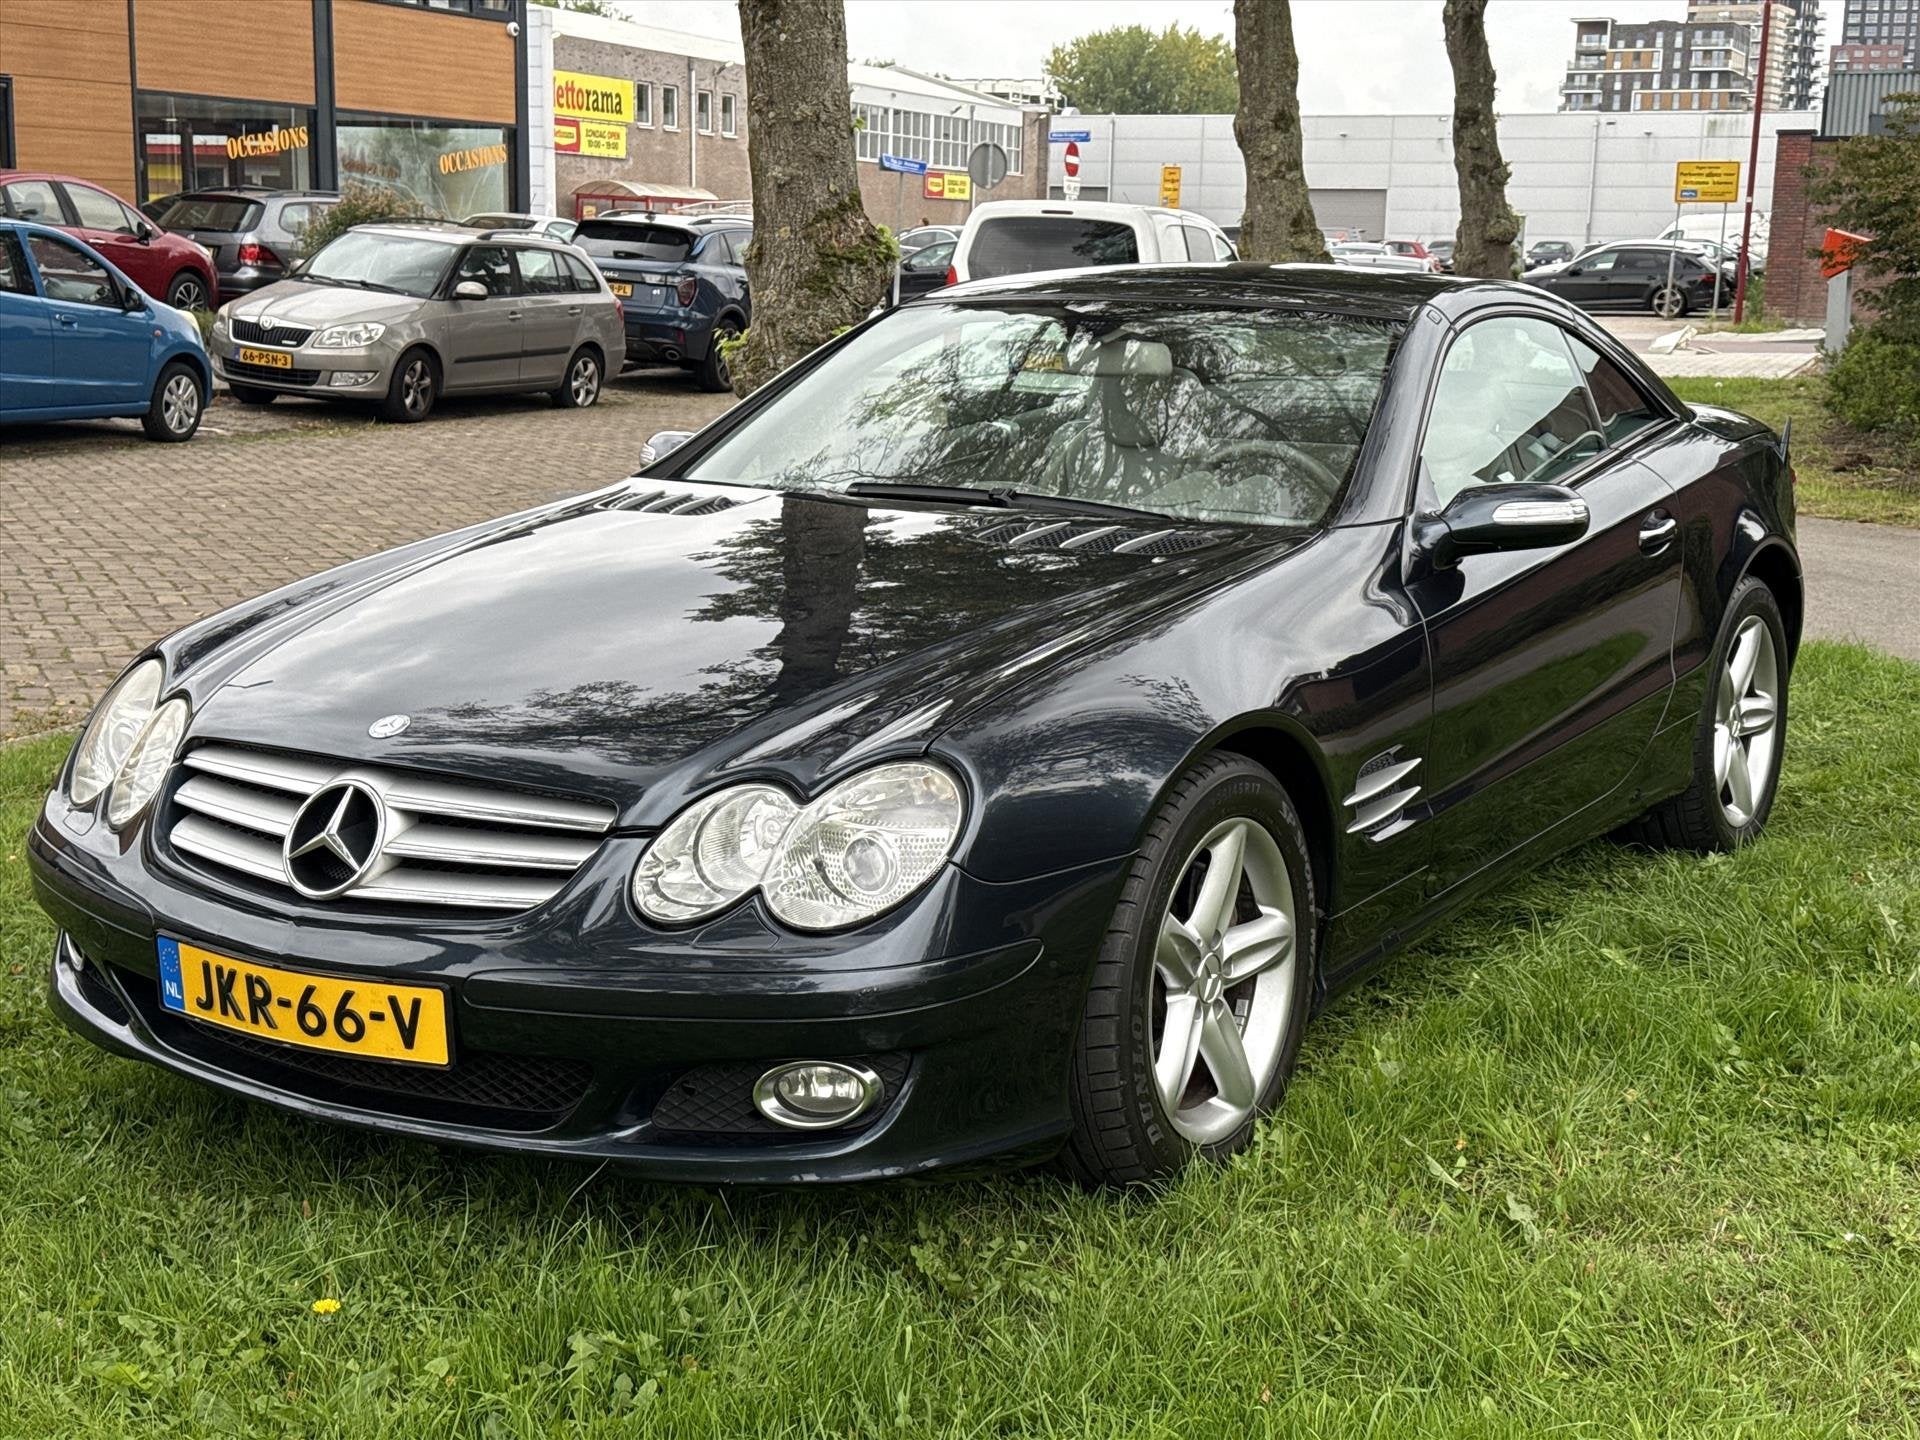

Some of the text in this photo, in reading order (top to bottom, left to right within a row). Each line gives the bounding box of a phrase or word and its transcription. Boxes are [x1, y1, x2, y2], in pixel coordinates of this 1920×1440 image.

[553, 76, 623, 115] ettorama
[226, 126, 308, 159] OCCASIONS
[607, 131, 620, 140] OPEN
[439, 143, 507, 175] OCCASIONS
[242, 351, 288, 366] 66-PSN-3
[165, 979, 182, 999] NL
[196, 960, 421, 1050] JKR-66-V
[1131, 981, 1164, 1146] DUNLOP
